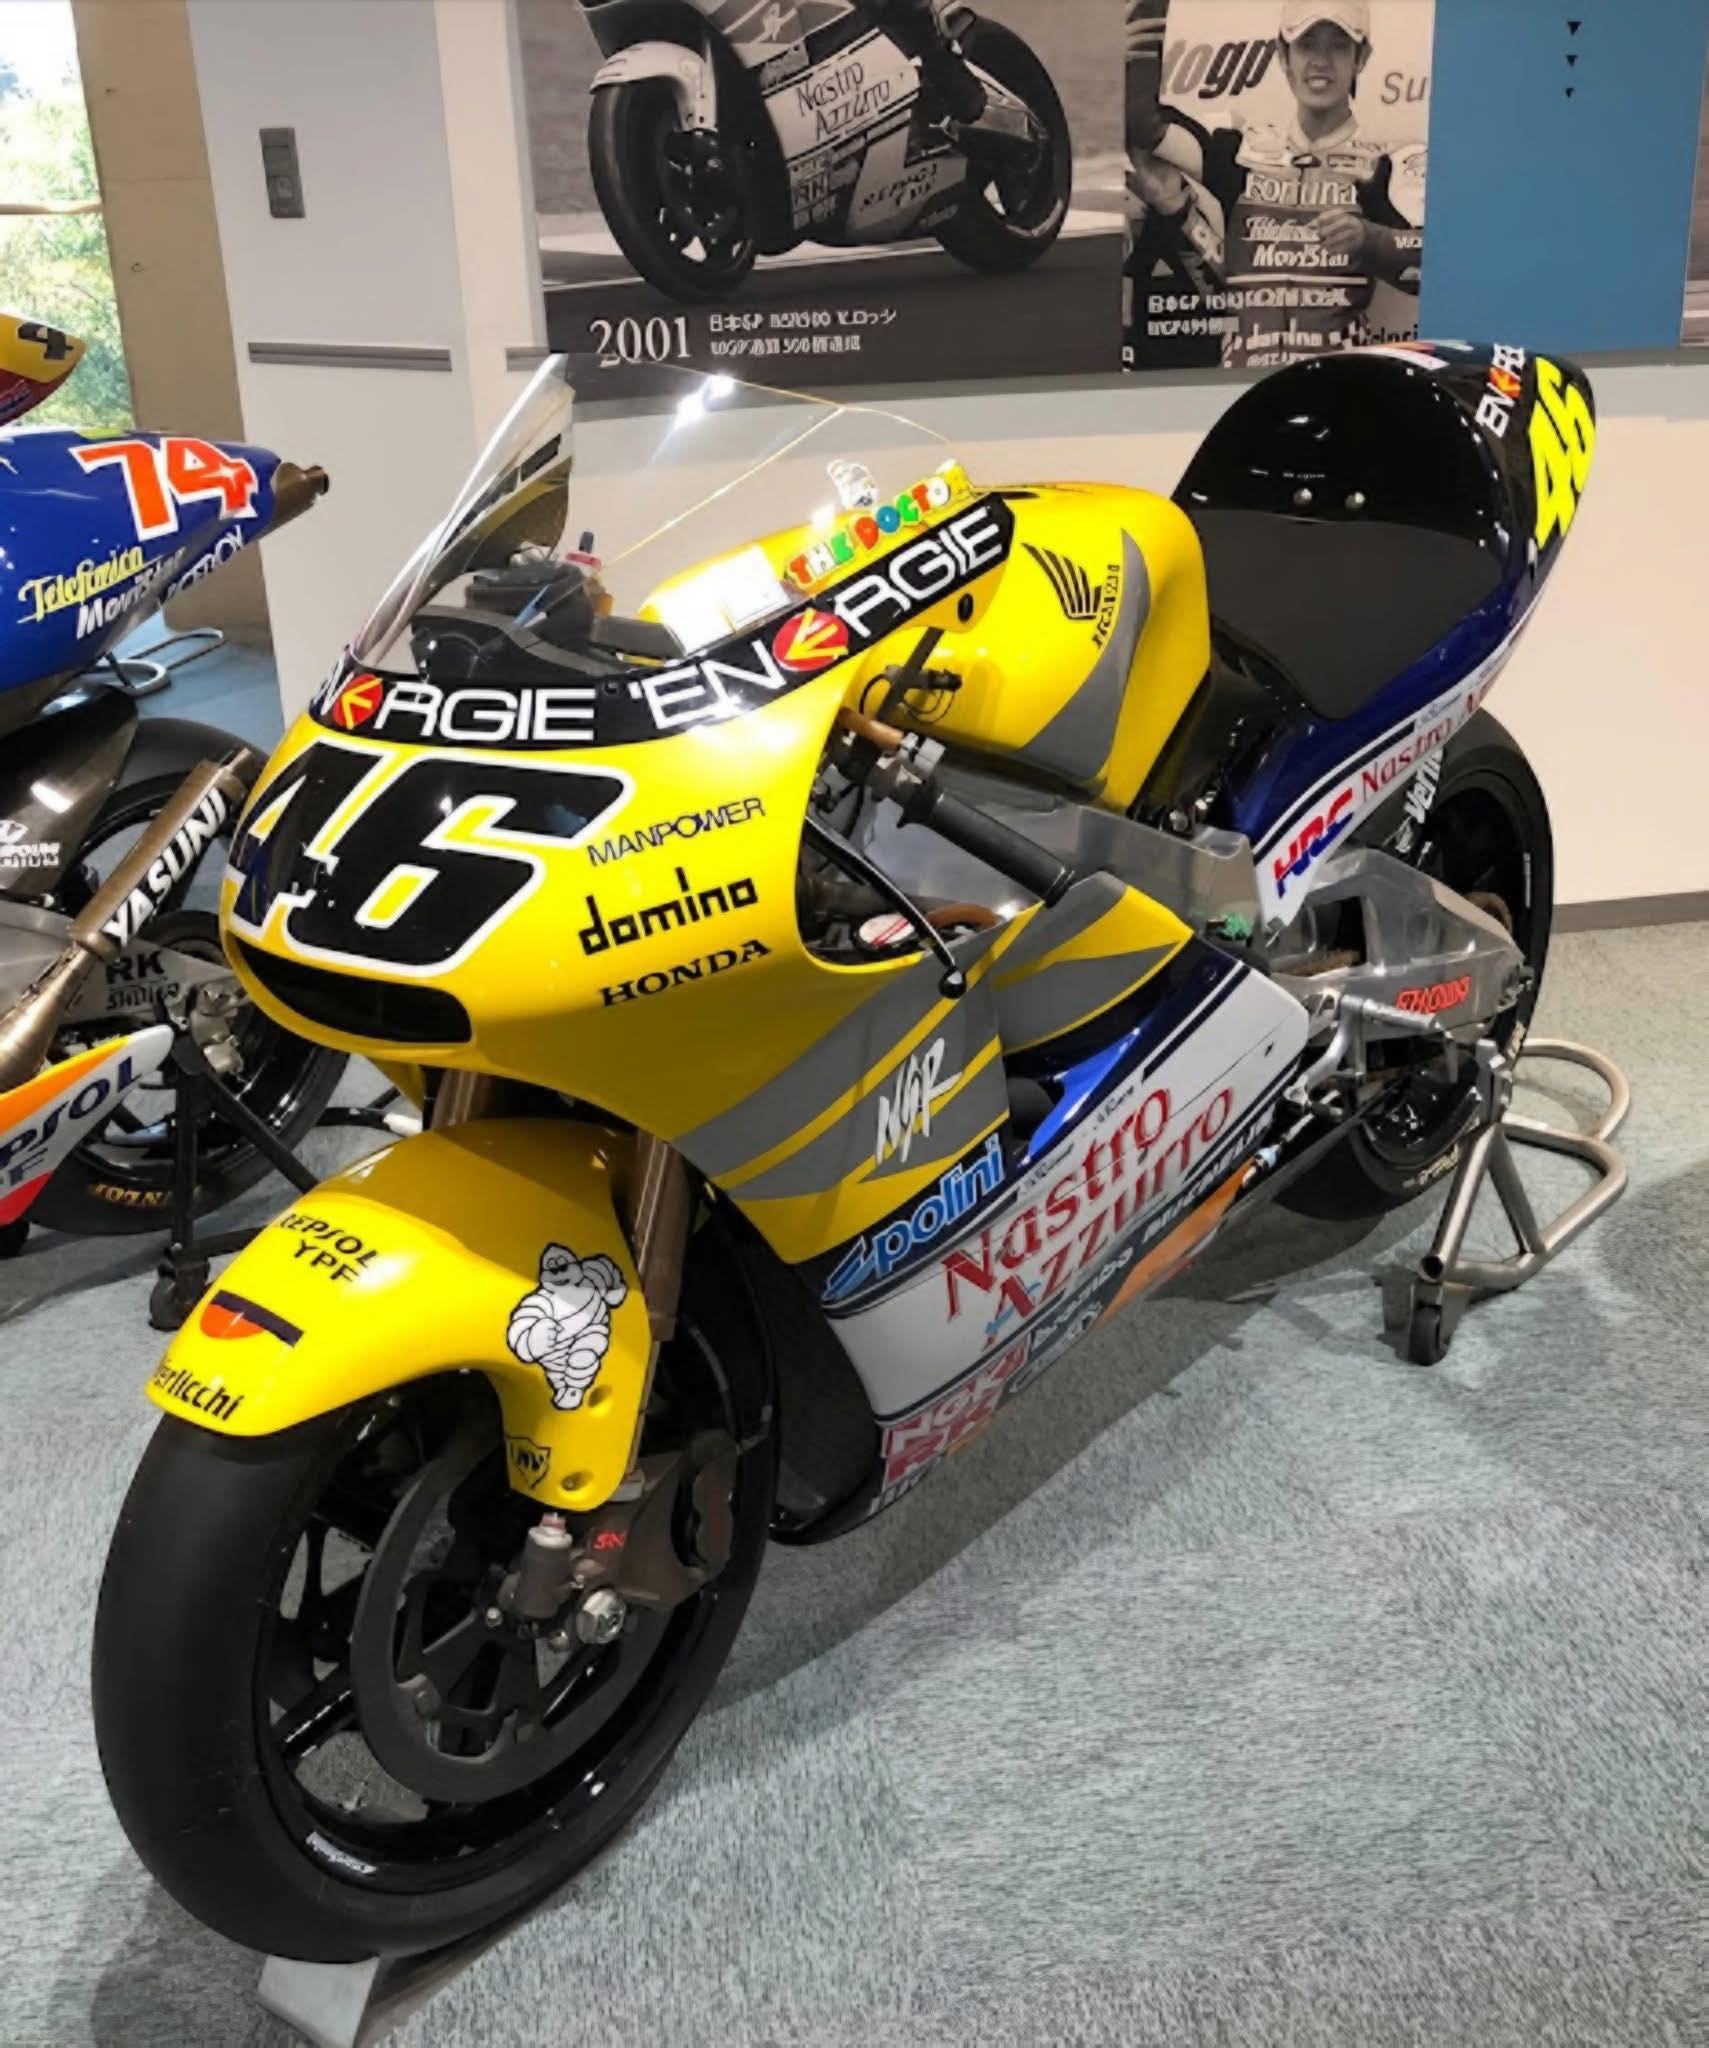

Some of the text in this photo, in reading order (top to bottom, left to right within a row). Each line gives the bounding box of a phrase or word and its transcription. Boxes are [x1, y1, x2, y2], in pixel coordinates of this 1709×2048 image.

[589, 316, 691, 367] 2001
[68, 437, 260, 542] 74
[1529, 356, 1597, 550] 46
[789, 531, 855, 585] THE
[103, 782, 227, 949] YASUNI
[219, 736, 637, 979] 46
[586, 796, 767, 868] MANPOWER
[1272, 786, 1354, 900] HRC
[577, 866, 759, 957] domino
[106, 949, 166, 985] RK
[598, 938, 772, 1007] HONDA
[872, 1132, 1006, 1276] polini
[942, 1086, 1173, 1323] Nastro
[981, 1085, 1235, 1352] Azzurro
[293, 1239, 363, 1285] YPF
